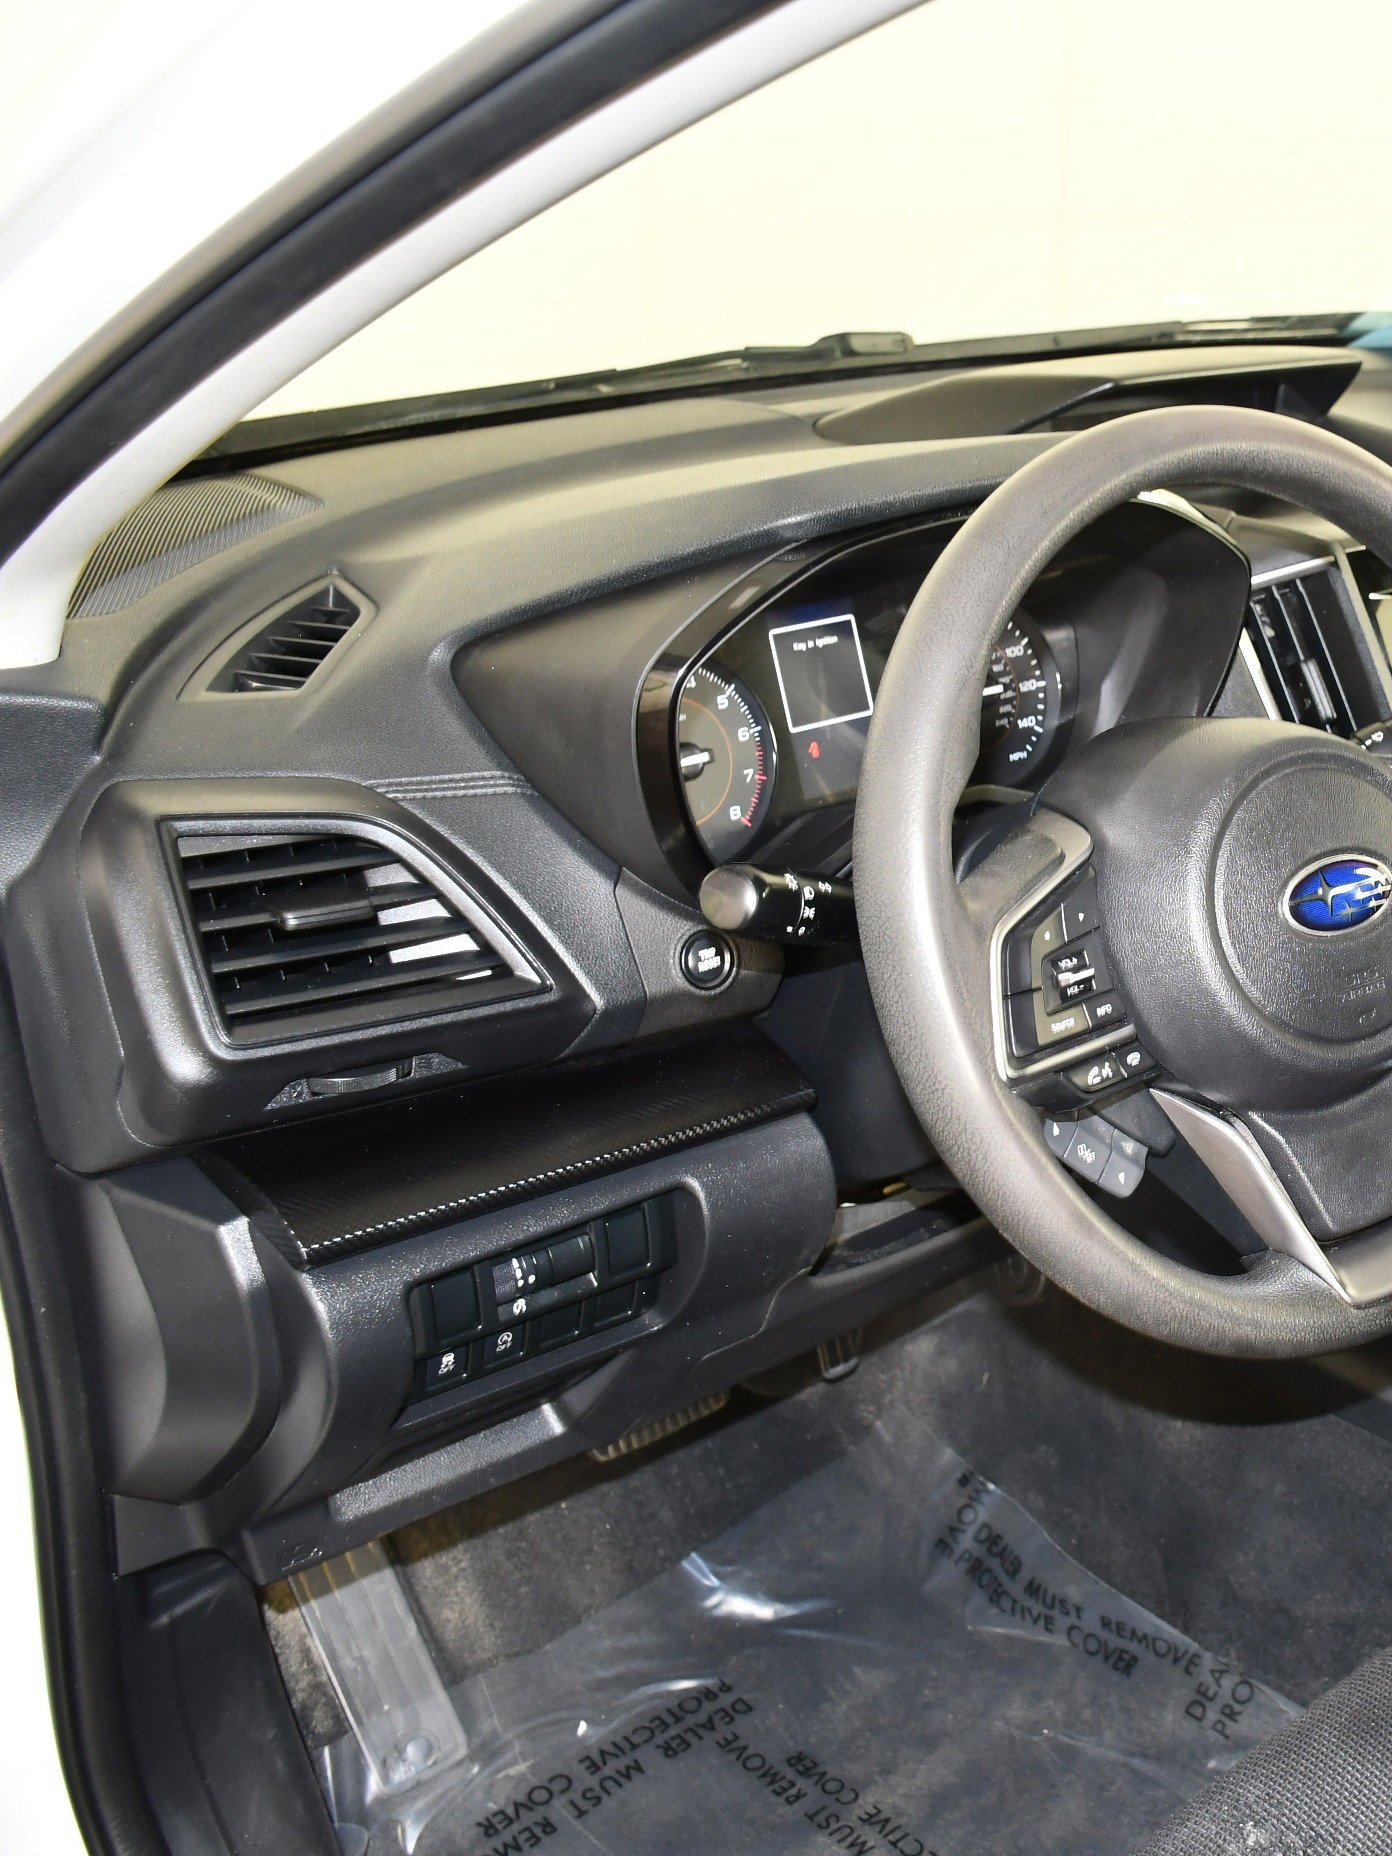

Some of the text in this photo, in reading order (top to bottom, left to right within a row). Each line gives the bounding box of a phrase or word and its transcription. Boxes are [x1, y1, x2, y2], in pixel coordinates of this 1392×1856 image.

[1005, 644, 1025, 659] 100
[716, 694, 729, 710] 5
[1018, 678, 1037, 693] 120
[737, 726, 750, 743] 6
[1016, 715, 1037, 730] 140
[743, 767, 754, 783] 7
[729, 805, 742, 821] 8
[1023, 1575, 1085, 1621] MUST
[1100, 1614, 1203, 1677] REMOVE
[1065, 1622, 1140, 1679] COVER
[656, 1697, 753, 1759] DEALER
[475, 1676, 734, 1839] PROTECTIVE COVER
[569, 1757, 645, 1819] MUST
[715, 1731, 877, 1856] MUST REMOVE
[786, 1750, 860, 1806] COVER
